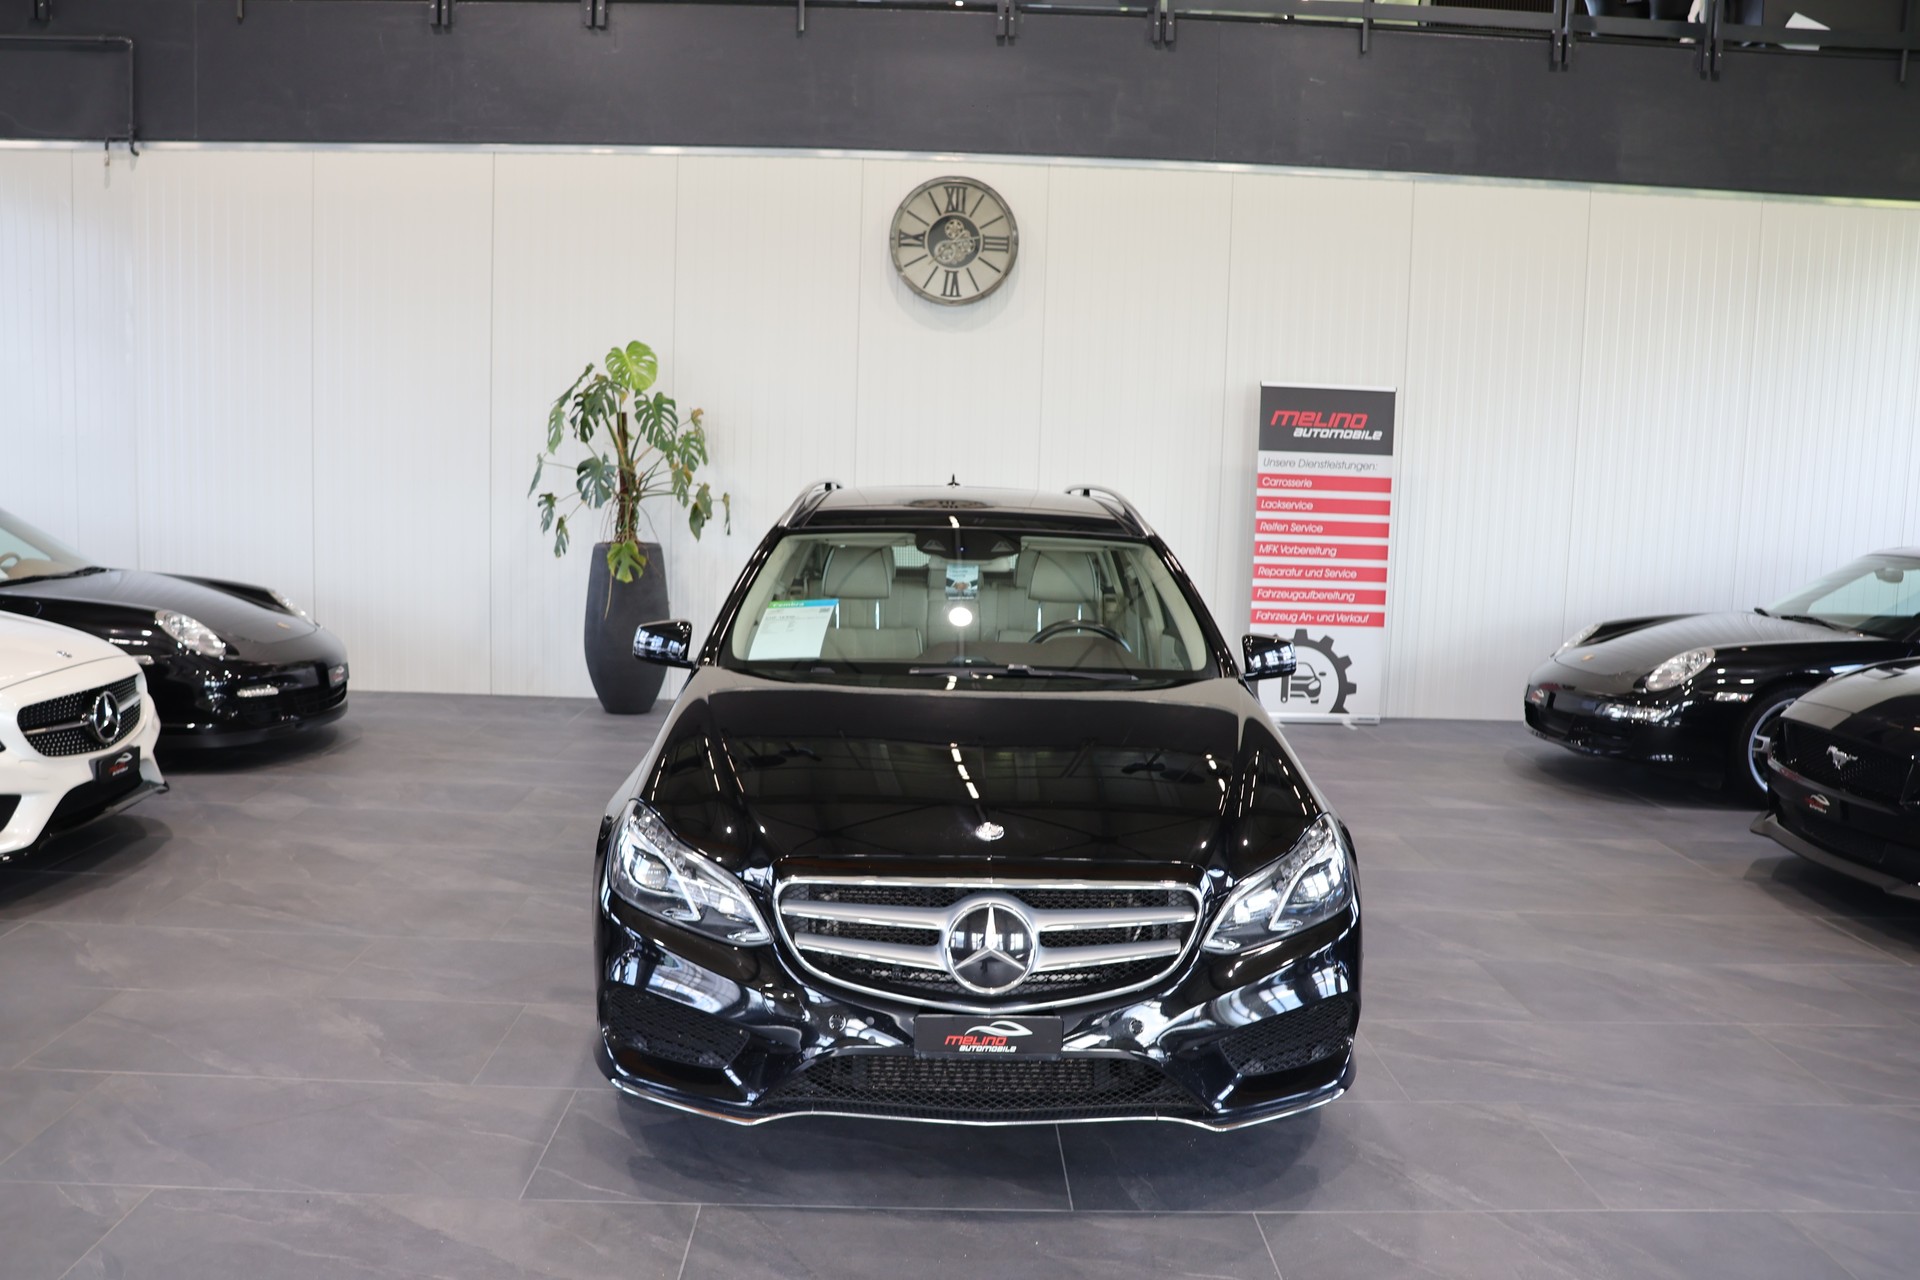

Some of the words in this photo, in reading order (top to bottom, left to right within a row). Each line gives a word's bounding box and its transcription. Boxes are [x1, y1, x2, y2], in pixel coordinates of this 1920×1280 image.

[1263, 457, 1296, 468] Unsere
[1298, 458, 1378, 473] Dienstleistungen:
[1262, 476, 1313, 488] Carrosserie
[1261, 499, 1313, 511] Lackservice
[1260, 521, 1289, 532] Reifen
[1290, 522, 1324, 533] Service
[1259, 544, 1279, 554] MFK
[1280, 544, 1338, 557] Vorbereitung
[1258, 566, 1303, 578] Reparatur
[1305, 567, 1323, 578] und
[1324, 568, 1357, 579] Service
[1257, 588, 1355, 602] Fahrzeugaufbereitung
[1256, 610, 1297, 623] Fahrzeug
[1299, 612, 1315, 621] An-
[1317, 612, 1335, 622] und
[1336, 613, 1369, 624] Verkauf
